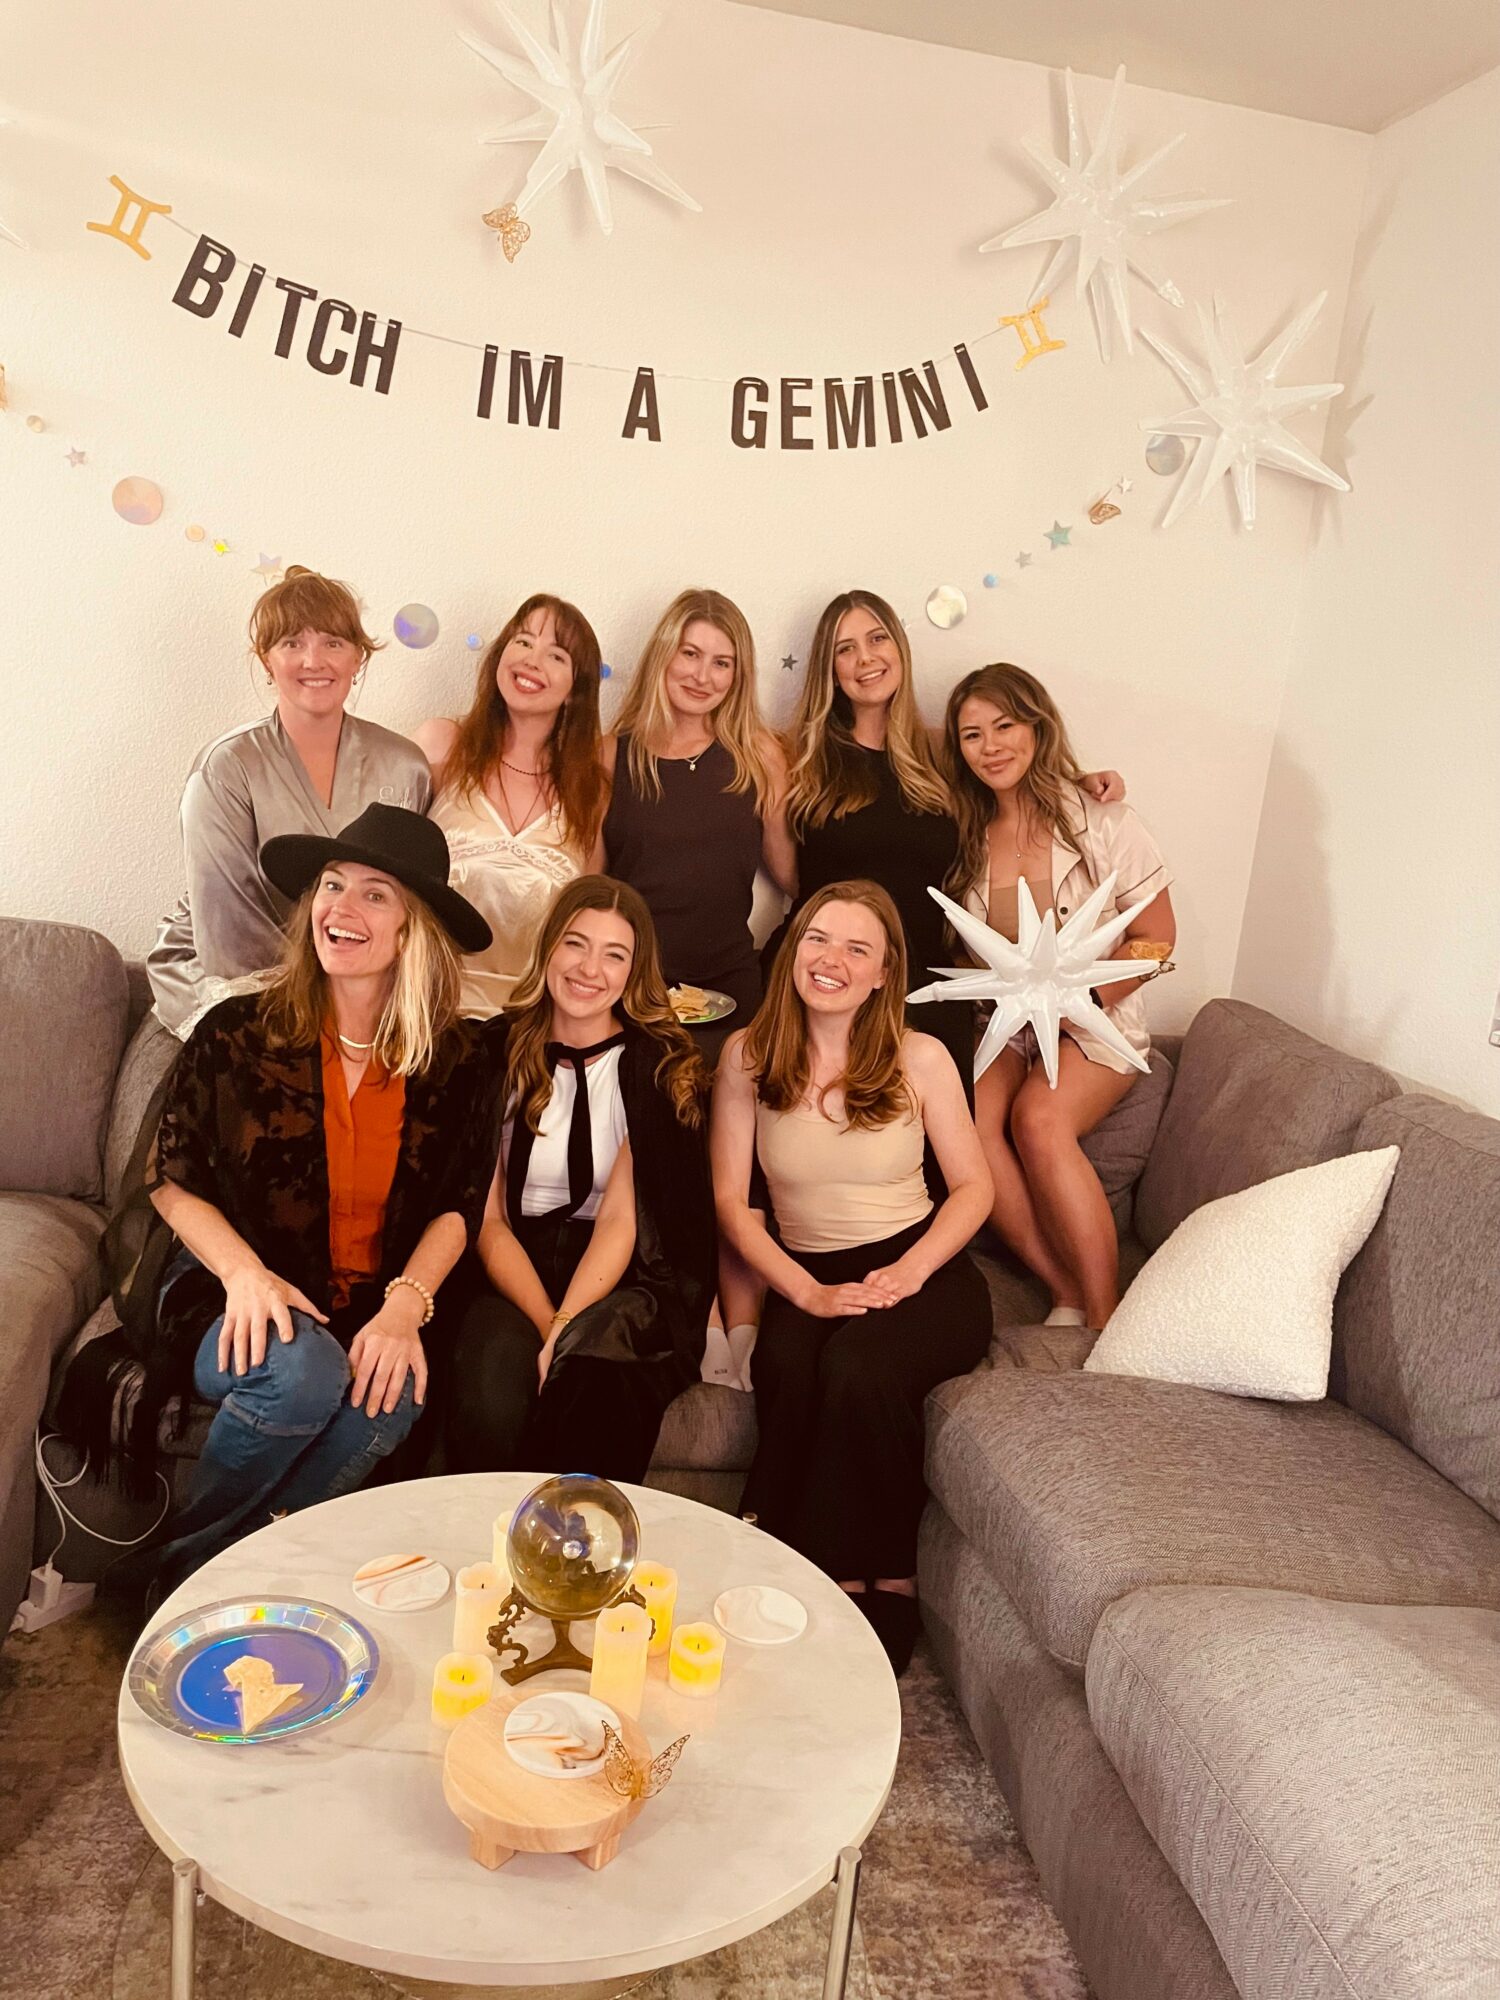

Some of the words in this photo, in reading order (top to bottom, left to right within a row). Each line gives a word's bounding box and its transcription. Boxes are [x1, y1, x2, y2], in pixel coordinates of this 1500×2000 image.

[171, 233, 403, 395] BITCH
[476, 343, 564, 430] IM
[621, 366, 662, 442] A
[731, 342, 989, 450] GEMINI
